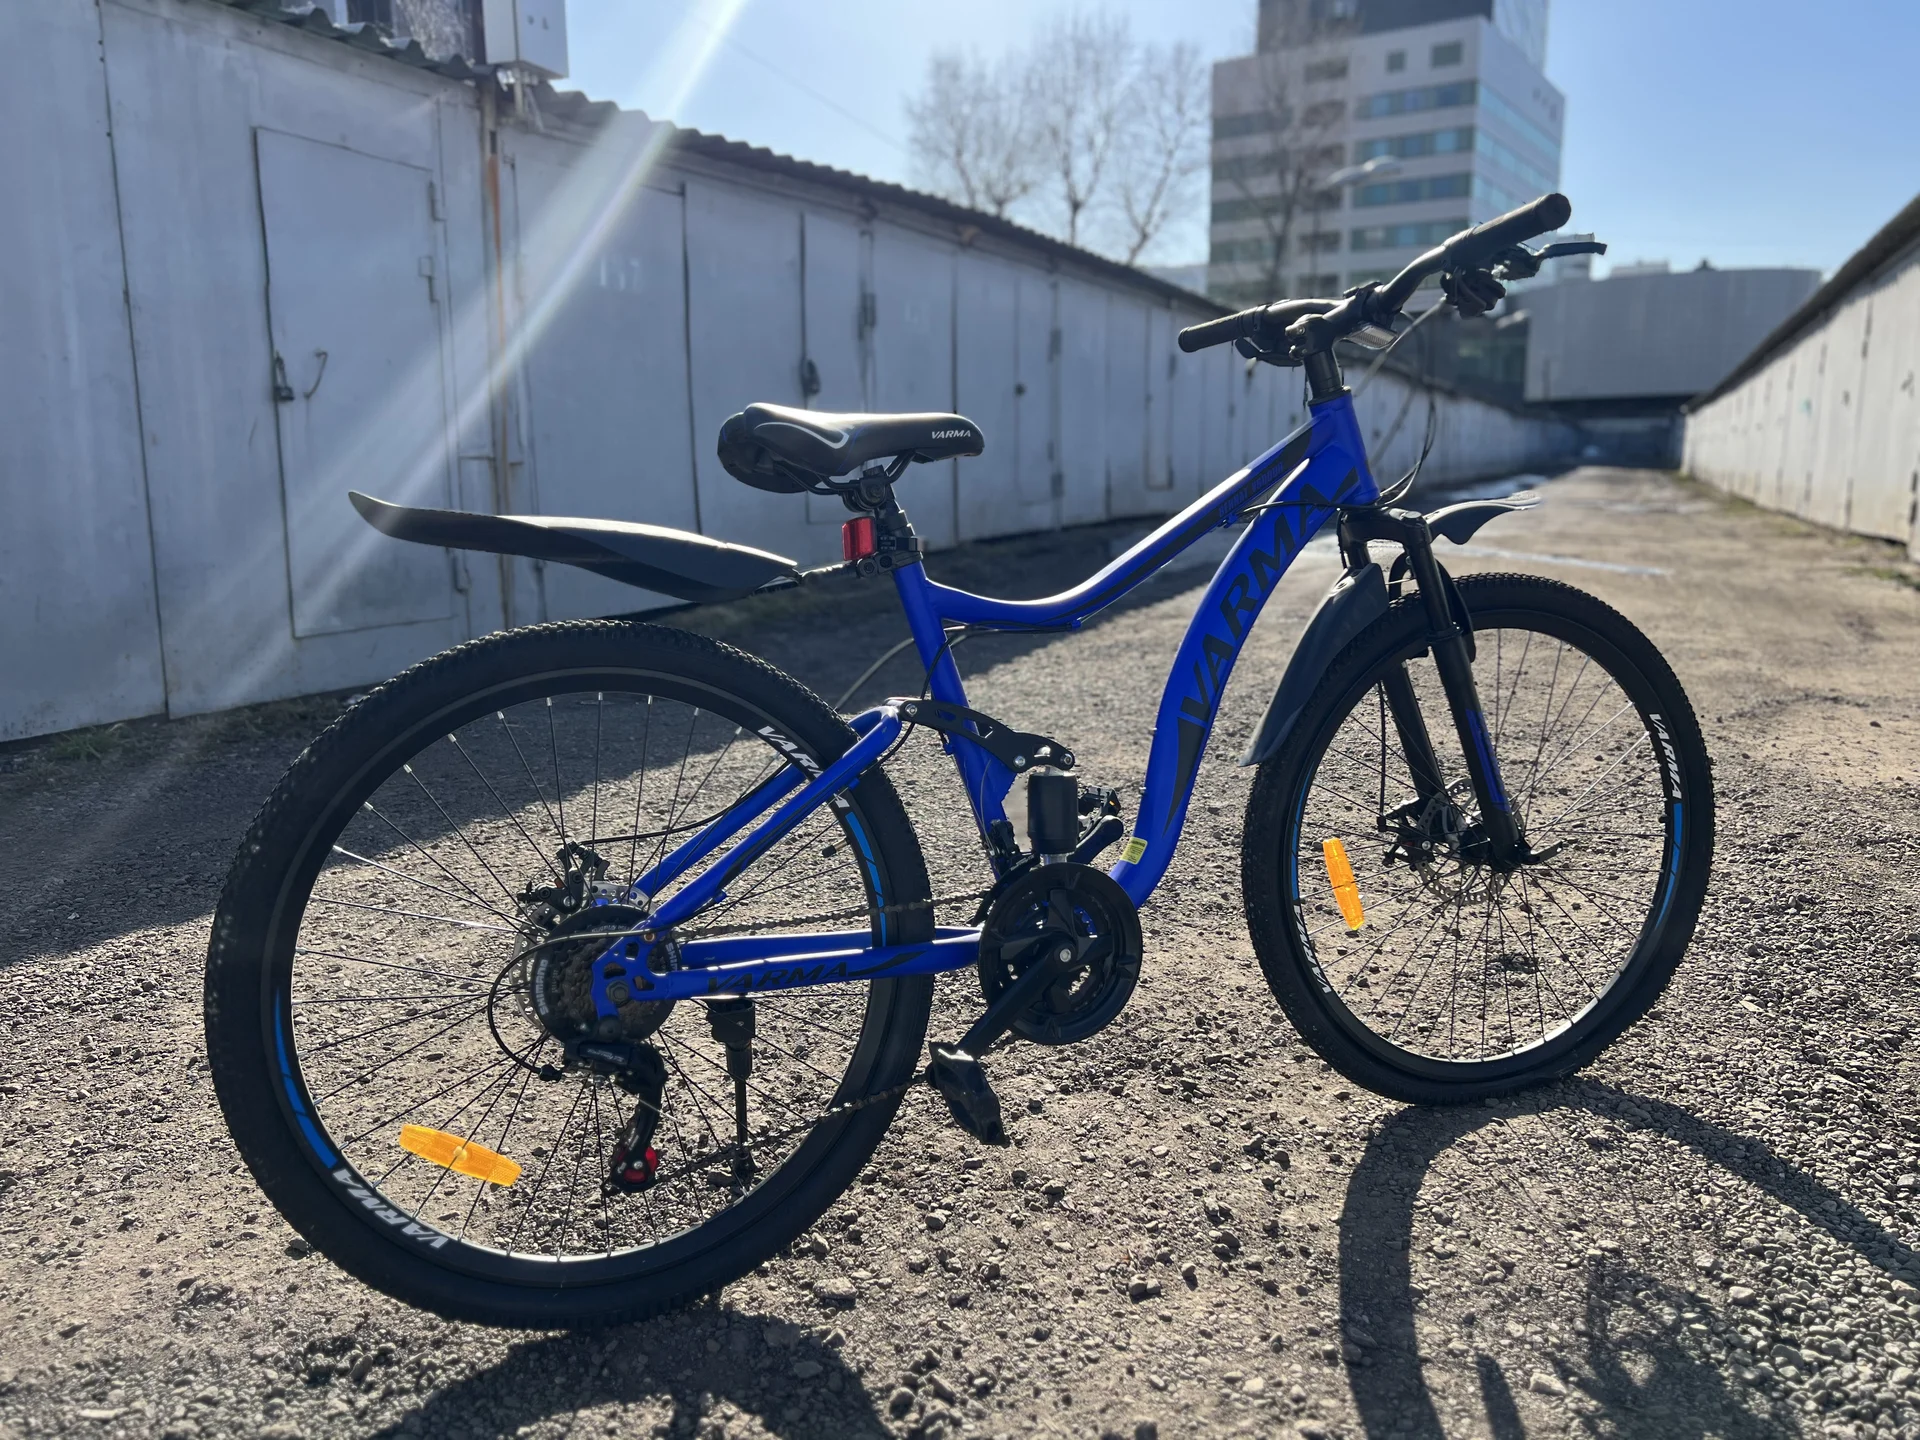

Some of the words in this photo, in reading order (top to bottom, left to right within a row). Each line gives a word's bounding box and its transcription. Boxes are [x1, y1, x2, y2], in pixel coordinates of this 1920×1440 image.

[931, 429, 971, 439] VARMA
[1181, 483, 1331, 726] VARMA
[1649, 714, 1682, 799] VARMA
[535, 959, 549, 1015] SHIMANO
[707, 961, 850, 993] VARMA
[1294, 905, 1332, 993] VARMA
[333, 1169, 449, 1249] VARMA
